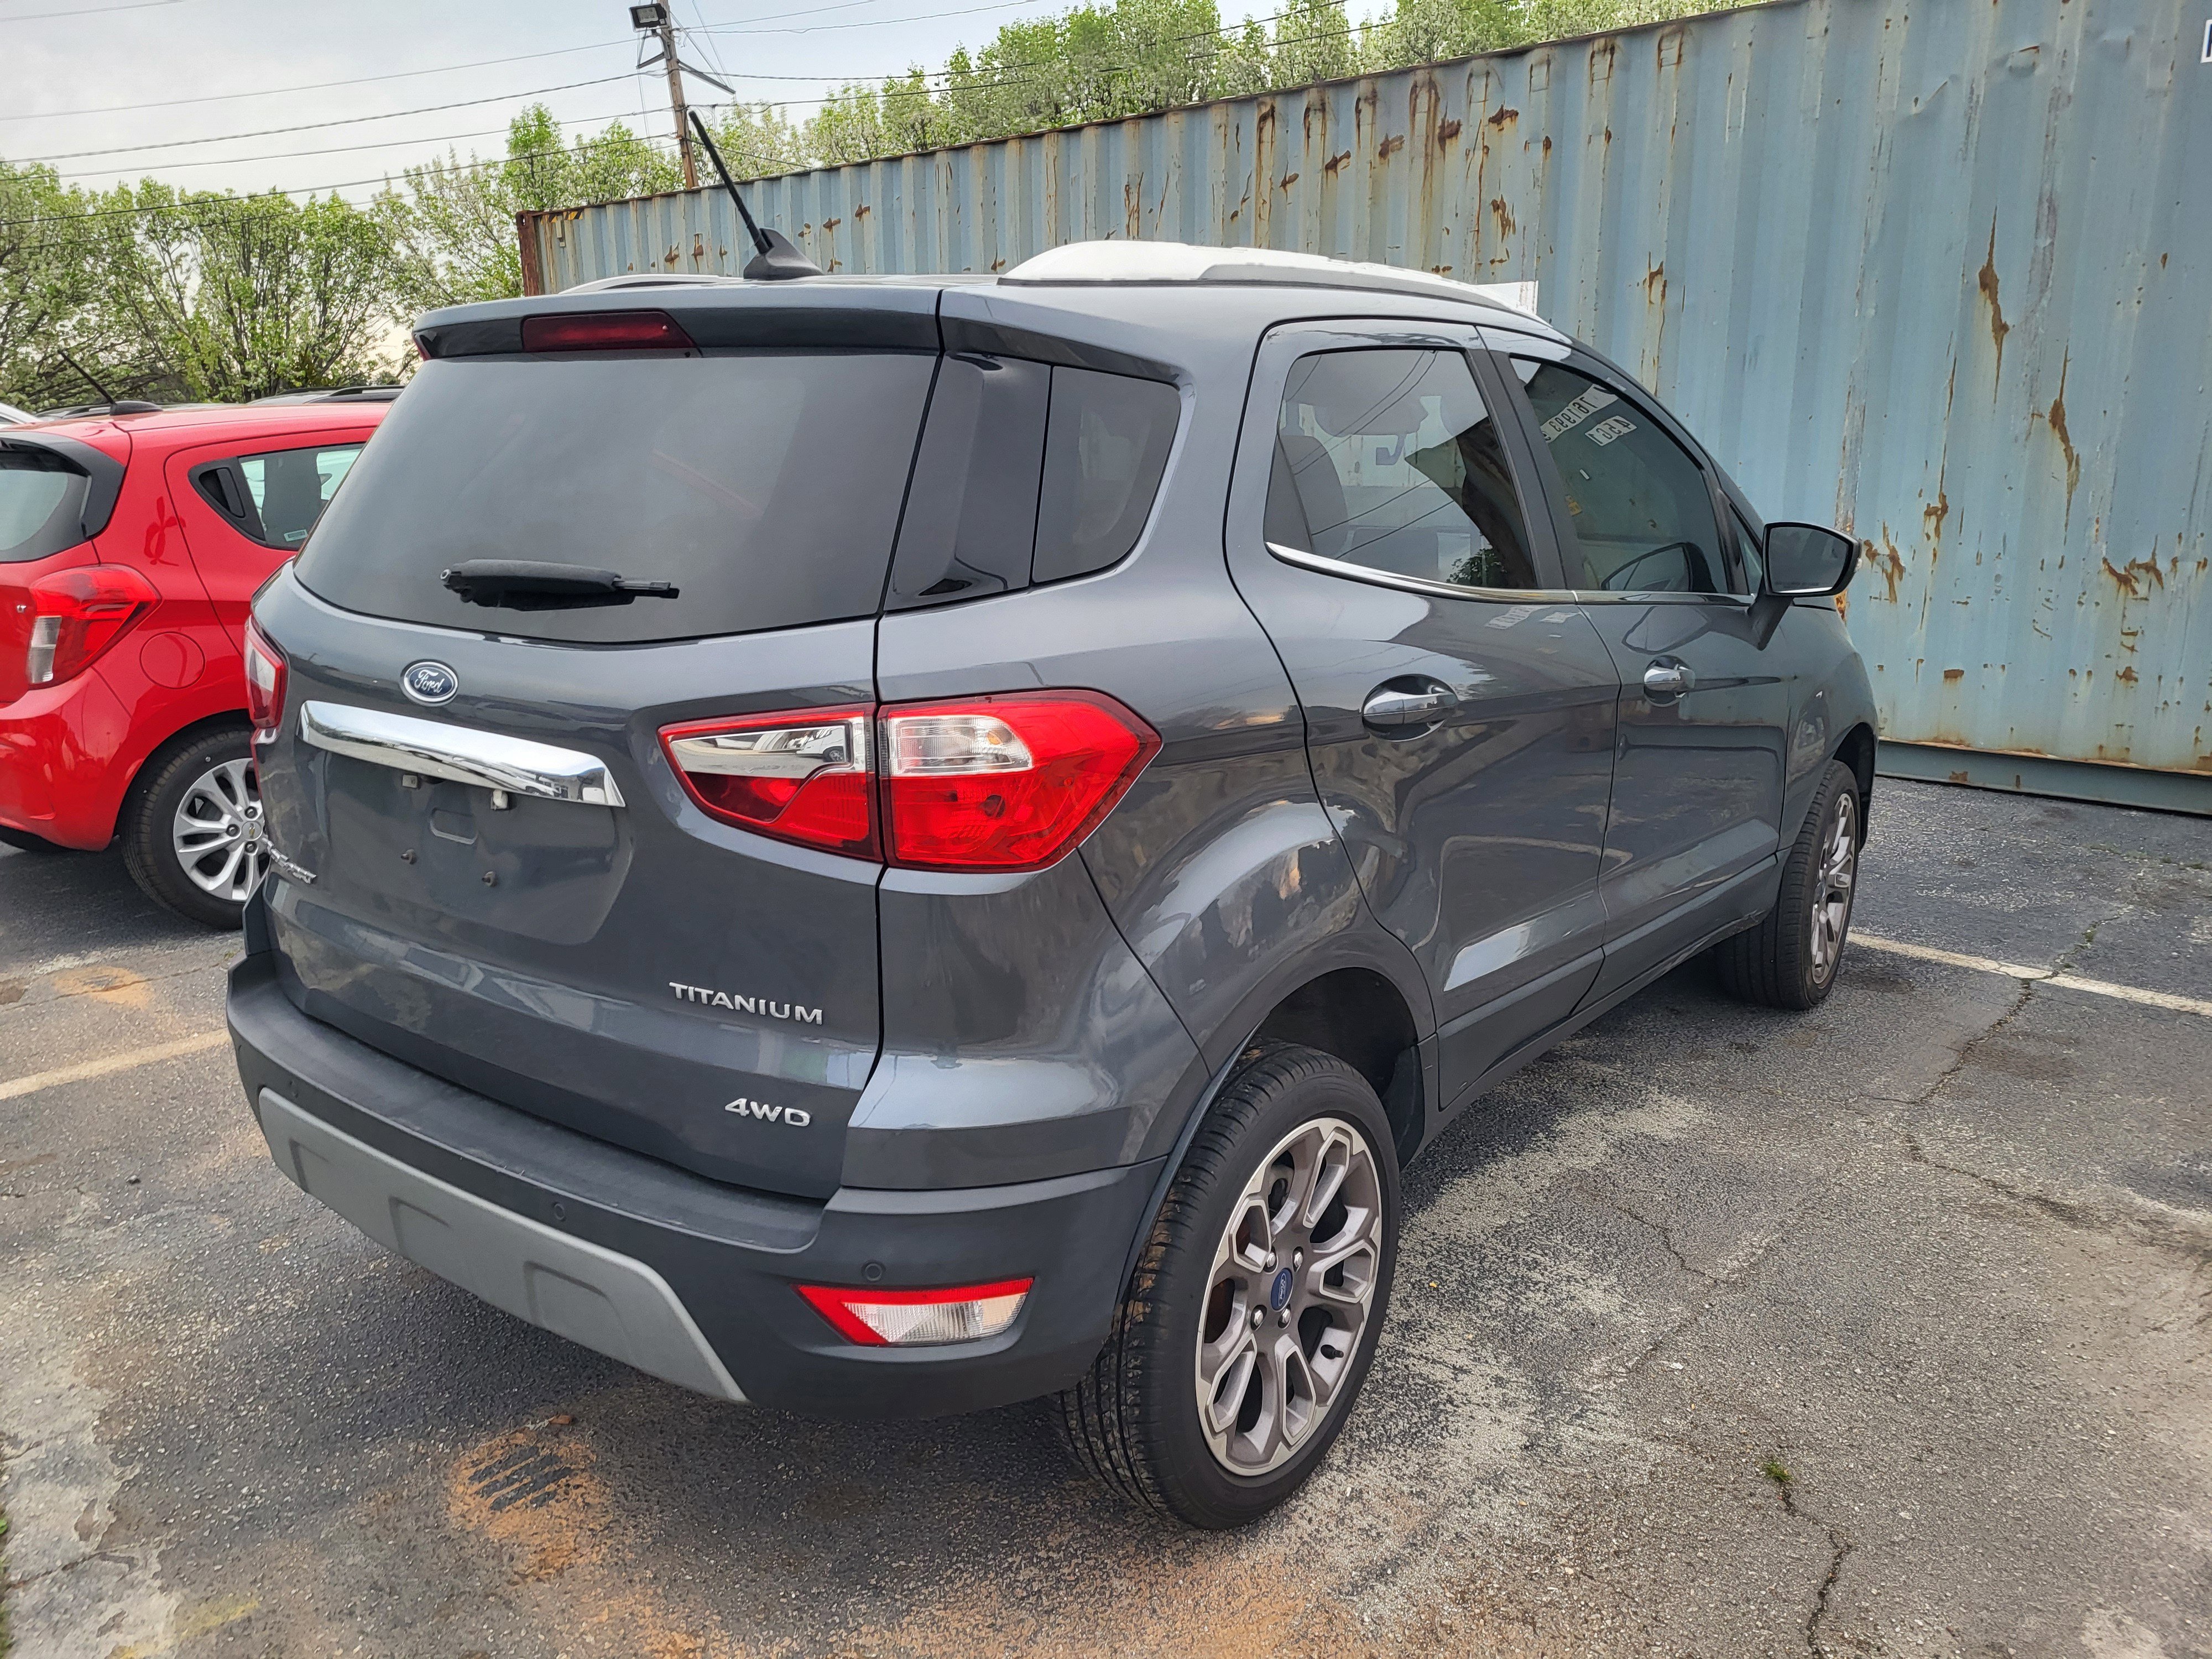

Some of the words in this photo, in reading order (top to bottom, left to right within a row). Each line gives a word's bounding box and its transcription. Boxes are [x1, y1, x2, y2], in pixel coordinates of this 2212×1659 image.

[414, 669, 445, 693] Ford
[669, 982, 823, 1025] TITANIUM
[724, 1098, 811, 1127] 4WD
